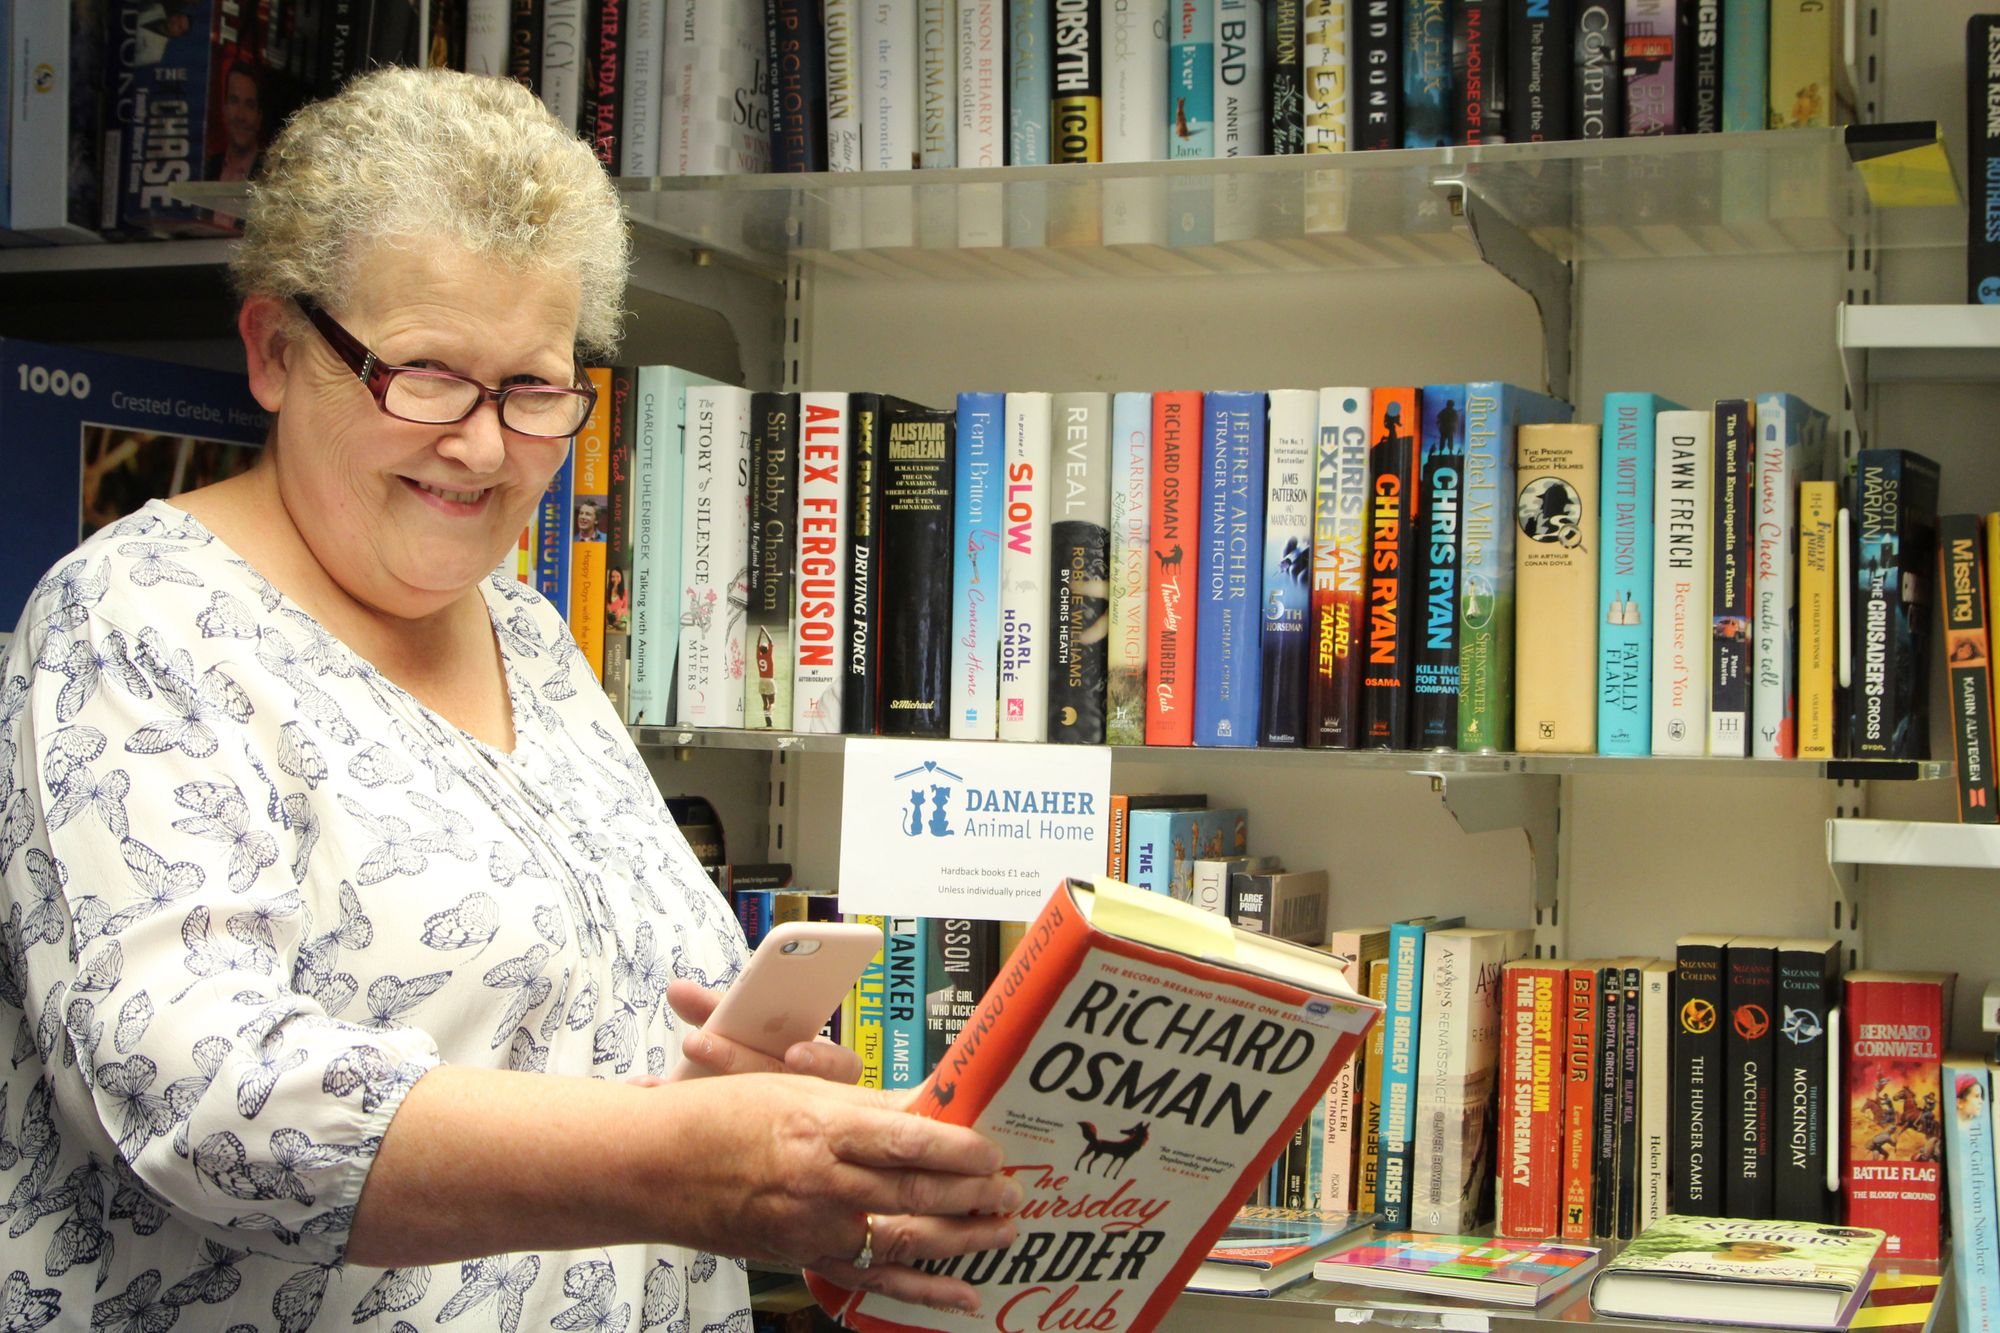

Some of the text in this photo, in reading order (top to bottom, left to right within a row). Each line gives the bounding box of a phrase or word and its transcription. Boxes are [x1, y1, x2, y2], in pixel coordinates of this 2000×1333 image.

[1221, 20, 1246, 86] BAD
[1531, 23, 1544, 44] The
[962, 8, 977, 129] barefoot soldier
[1369, 49, 1388, 125] GONE
[1466, 44, 1481, 101] HOUSE
[1528, 46, 1544, 93] Naming
[1226, 96, 1239, 142] ANNIE
[1466, 103, 1481, 127] OF
[141, 99, 192, 210] CHASE
[18, 363, 91, 399] 1000
[111, 391, 171, 416] Crested
[697, 411, 713, 472] STORY
[803, 404, 840, 485] ALEX
[888, 440, 946, 459] MacLEAN
[889, 422, 946, 440] ALISTAIR
[1273, 448, 1309, 456] International
[584, 436, 601, 489] Oliver
[969, 411, 990, 524] Fern Britton
[1065, 406, 1089, 515] REVEAL
[1276, 457, 1305, 465] Bestseller
[1281, 473, 1299, 485] JAMES
[760, 411, 787, 611] Sir Bobby Charlton
[1007, 462, 1034, 556] SLOW
[1163, 477, 1181, 540] OSMAN
[1211, 411, 1229, 601] STRANGER THAN FICTION
[1228, 411, 1250, 600] JEFFREY ARCHER
[1271, 488, 1308, 502] PATTERSON
[1313, 425, 1340, 592] EXTREME
[1337, 425, 1366, 592] CHRIS RYAN
[1615, 406, 1638, 577] DIANE MOTT DAVIDSON
[1669, 436, 1696, 569] DAWN FRENCH
[1723, 414, 1737, 608] The World Encyclopedia of Trucks
[1862, 466, 1883, 544] MARIANI
[1882, 480, 1898, 532] SCOTT
[695, 497, 711, 585] SILENCE
[1427, 467, 1459, 649] CHRIS RYAN
[636, 568, 650, 607] Talking
[799, 497, 838, 667] FERGUSON
[1369, 473, 1401, 664] CHRIS RYAN
[1952, 538, 1974, 623] Missing
[639, 610, 648, 634] with
[851, 544, 870, 677] DRIVING FORCE
[1058, 569, 1070, 664] BY CHRIS HEATH
[1265, 621, 1304, 633] HORSEMAN
[1333, 602, 1351, 659] HARD
[637, 637, 648, 683] Animals
[688, 639, 698, 691] MYERS
[699, 644, 709, 685] ALEX
[1017, 622, 1032, 669] CARL
[1160, 631, 1177, 685] MURDER
[1319, 603, 1335, 679] TARGET
[1671, 581, 1691, 708] Because of You
[1365, 678, 1400, 688] OSAMA
[1604, 649, 1622, 707] FLAKY
[1621, 642, 1639, 715] FATALLY
[1268, 733, 1295, 743] headline
[965, 789, 1096, 815] DANAHER
[963, 817, 1095, 841] Animal Home
[940, 866, 1040, 878] Hardback books £1 each
[1139, 843, 1154, 874] THE
[937, 885, 1042, 899] Unless individually priced
[1239, 893, 1264, 903] LARGE
[1239, 903, 1263, 912] PRINT
[889, 918, 917, 1082] LANKER JAMES
[940, 990, 974, 1002] THE GIRL
[1680, 971, 1717, 981] COLLINS
[1783, 980, 1820, 990] COLLINS
[931, 1005, 979, 1017] WHO KICKE
[953, 999, 1004, 1074] OSMAN
[1570, 977, 1591, 1083] BEN-HUR
[1606, 1005, 1617, 1049] HOSPITAL
[1859, 1024, 1931, 1040] BERNARD
[865, 1032, 877, 1060] The
[1533, 976, 1553, 1113] ROBERT LUDLUM
[1604, 1051, 1615, 1089] CIRCLES
[1854, 1040, 1938, 1058] CORNWELL
[1028, 1040, 1272, 1135] OSMAN
[1339, 1074, 1350, 1132] CAMILLERI
[1512, 976, 1535, 1188] THE BOURNE SUPREMACY
[1603, 1093, 1614, 1123] LUCILLA
[1327, 1080, 1338, 1144] TO TINDARI
[1690, 1056, 1704, 1201] THE HUNGER GAMES
[1743, 1061, 1757, 1179] CATCHING FIRE
[1790, 1067, 1807, 1169] MOCKINGJAY
[1968, 1124, 1982, 1147] The
[1602, 1123, 1613, 1159] ANDREWS
[1970, 1151, 1983, 1176] Girl
[1001, 1164, 1070, 1191] The
[1649, 1135, 1661, 1221] Helen Forrester
[1852, 1166, 1936, 1182] BATTLE FLAG
[1853, 1191, 1936, 1201] THE BLOODY GROUND
[1972, 1178, 1985, 1214] from
[1000, 1178, 1171, 1234] ursday
[1975, 1216, 1987, 1275] Nowhere
[995, 1284, 1125, 1333] Club
